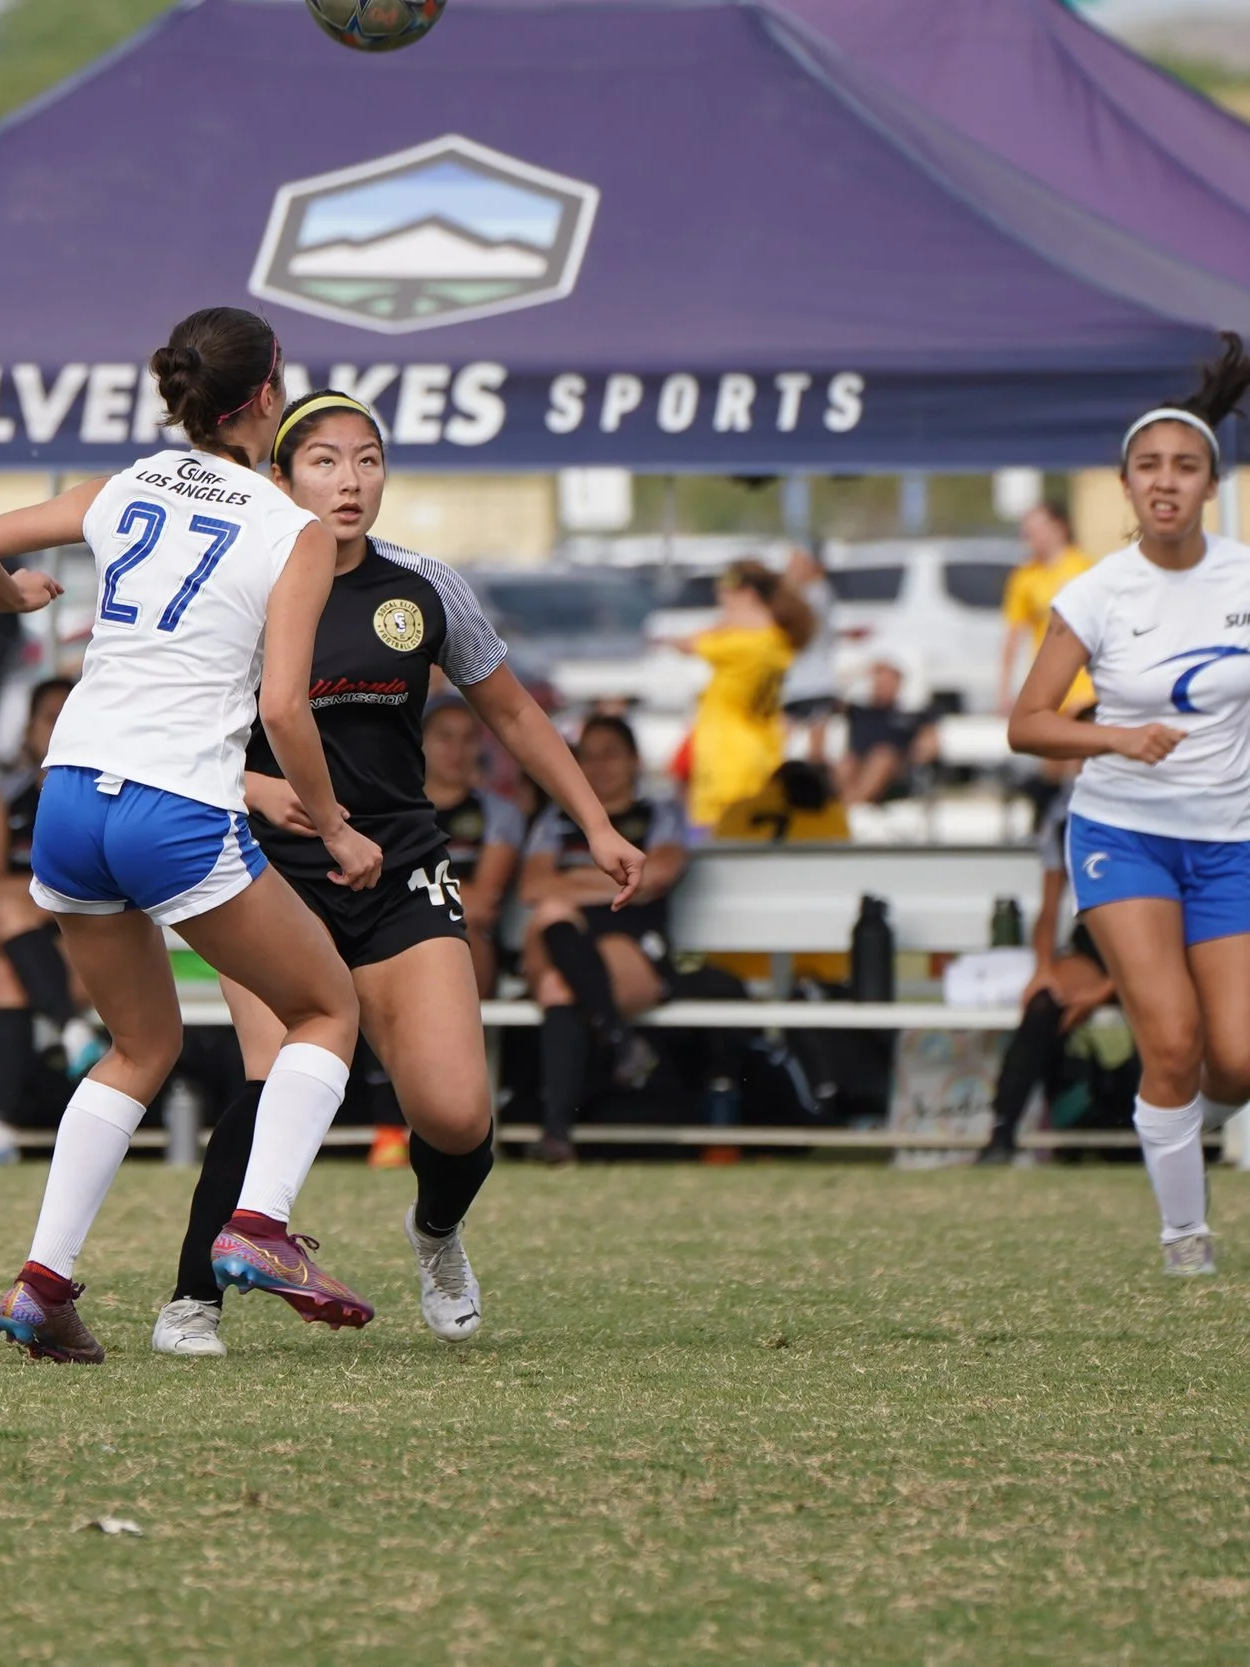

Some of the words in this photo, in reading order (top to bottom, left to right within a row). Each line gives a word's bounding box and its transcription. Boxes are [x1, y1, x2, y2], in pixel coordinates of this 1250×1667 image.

[544, 373, 864, 433] SPORTS
[135, 470, 172, 488] LOS
[167, 481, 252, 506] ANGELES
[187, 467, 228, 485] SURF
[100, 500, 242, 632] 27
[377, 601, 397, 617] SOCAL
[399, 601, 419, 614] ELITE
[378, 629, 412, 650] FOOTBALL
[410, 629, 422, 647] CLUB
